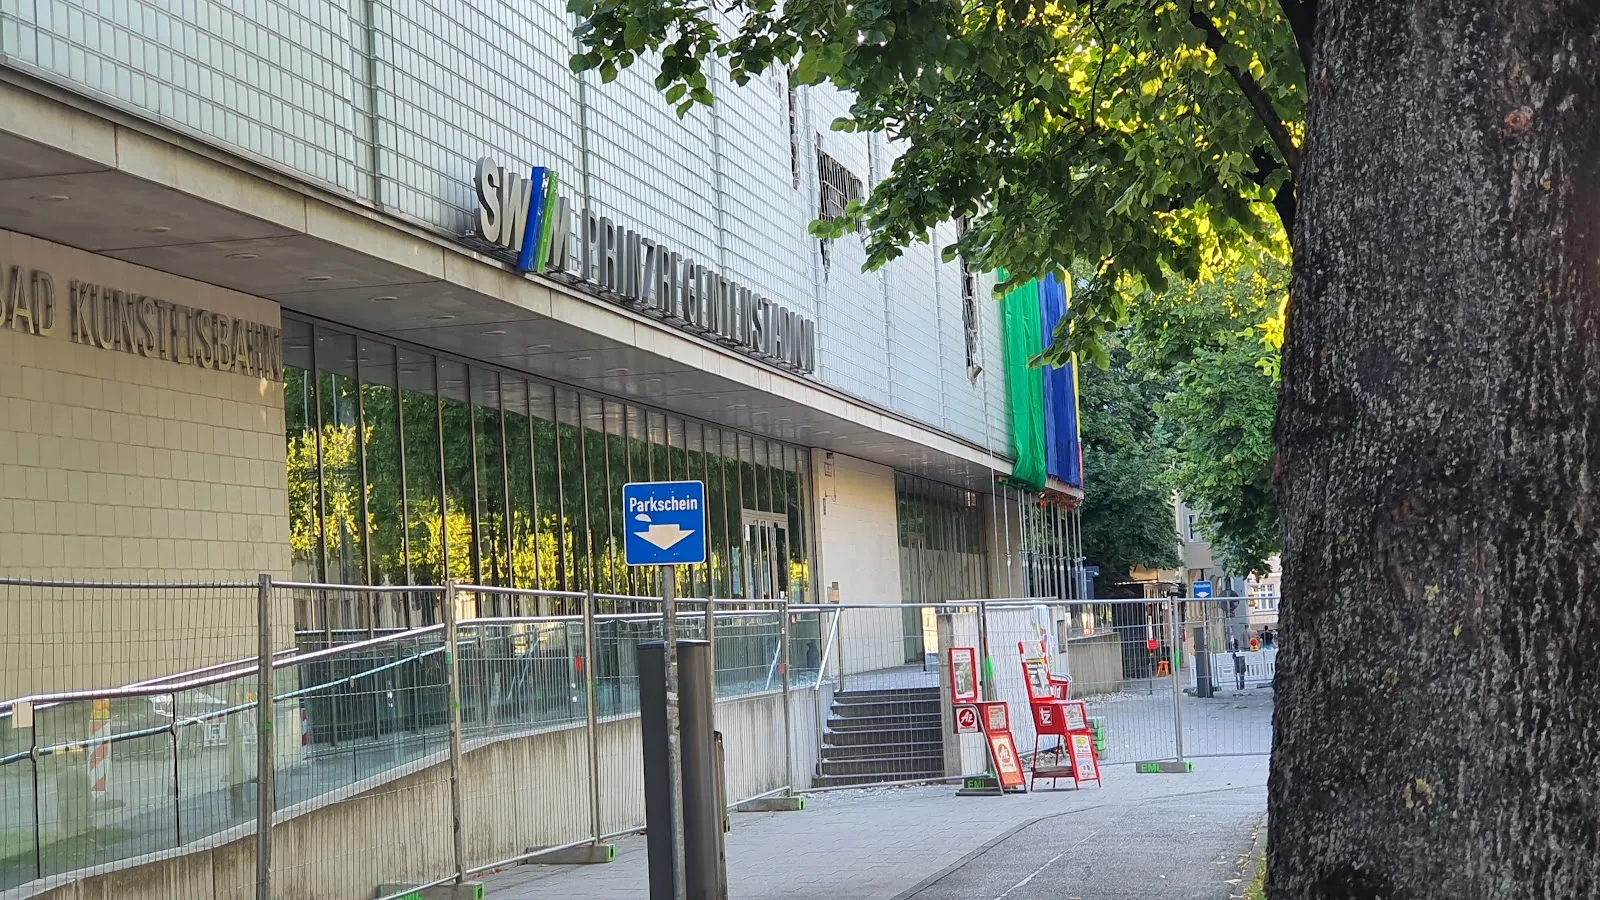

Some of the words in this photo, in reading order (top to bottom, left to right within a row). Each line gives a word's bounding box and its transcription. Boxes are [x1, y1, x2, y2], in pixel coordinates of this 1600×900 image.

[71, 279, 282, 381] KUNSTEISBAHN
[581, 207, 816, 375] PRINZREGENTENSTADION
[629, 495, 698, 512] Parkschein
